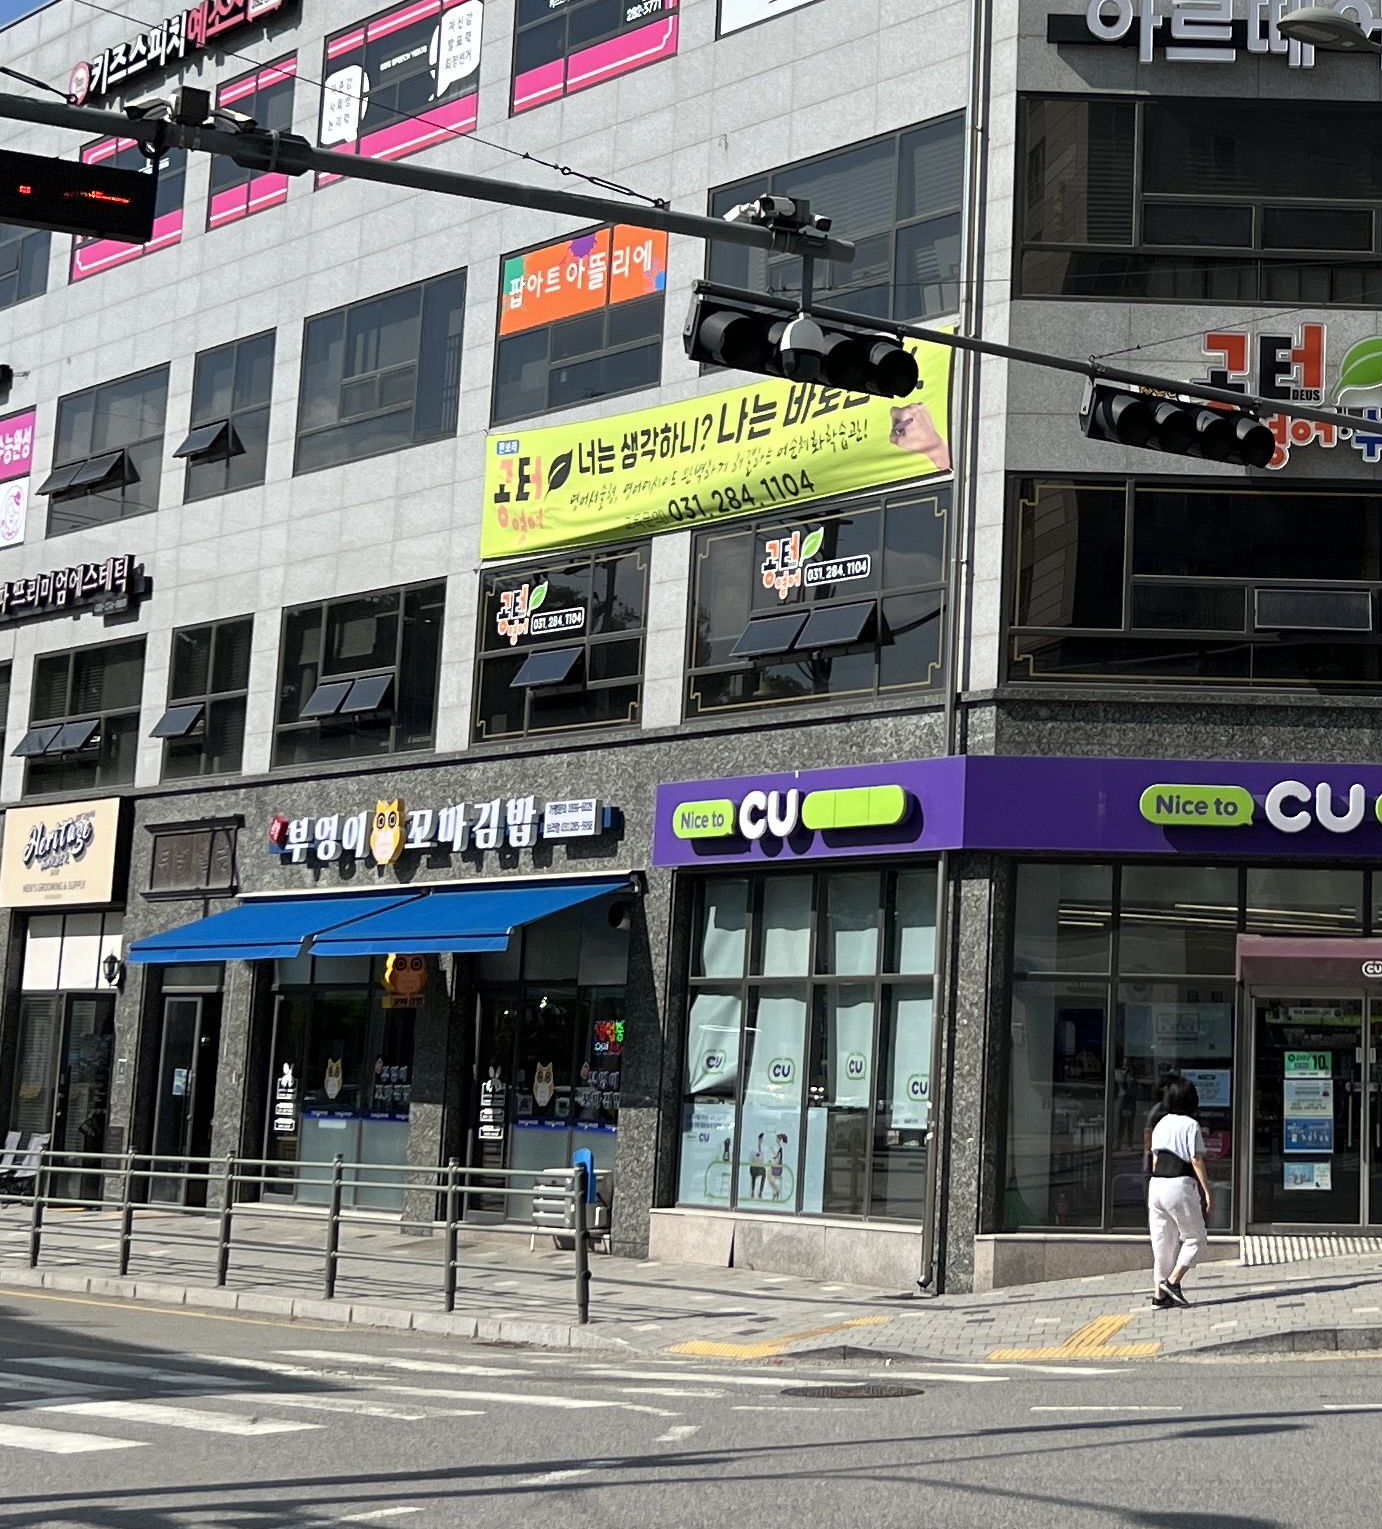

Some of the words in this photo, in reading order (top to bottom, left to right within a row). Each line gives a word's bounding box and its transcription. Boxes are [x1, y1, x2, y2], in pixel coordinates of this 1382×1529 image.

[90, 10, 187, 94] 키즈스피치
[1292, 389, 1320, 401] DEUS
[578, 438, 615, 475] 너는
[621, 413, 713, 470] 생각하니?
[717, 394, 778, 444] 나는
[288, 811, 368, 863] 부엉이
[405, 795, 537, 852] 꼬마김밥
[681, 811, 709, 829] Nice
[712, 811, 724, 828] to
[739, 788, 799, 840] CU
[1155, 794, 1209, 816] Nice
[1214, 797, 1238, 816] to
[1265, 780, 1365, 833] CU
[23, 821, 93, 865] Heritage
[773, 1064, 791, 1078] CU
[849, 1059, 863, 1074] CU
[911, 1081, 929, 1095] CU
